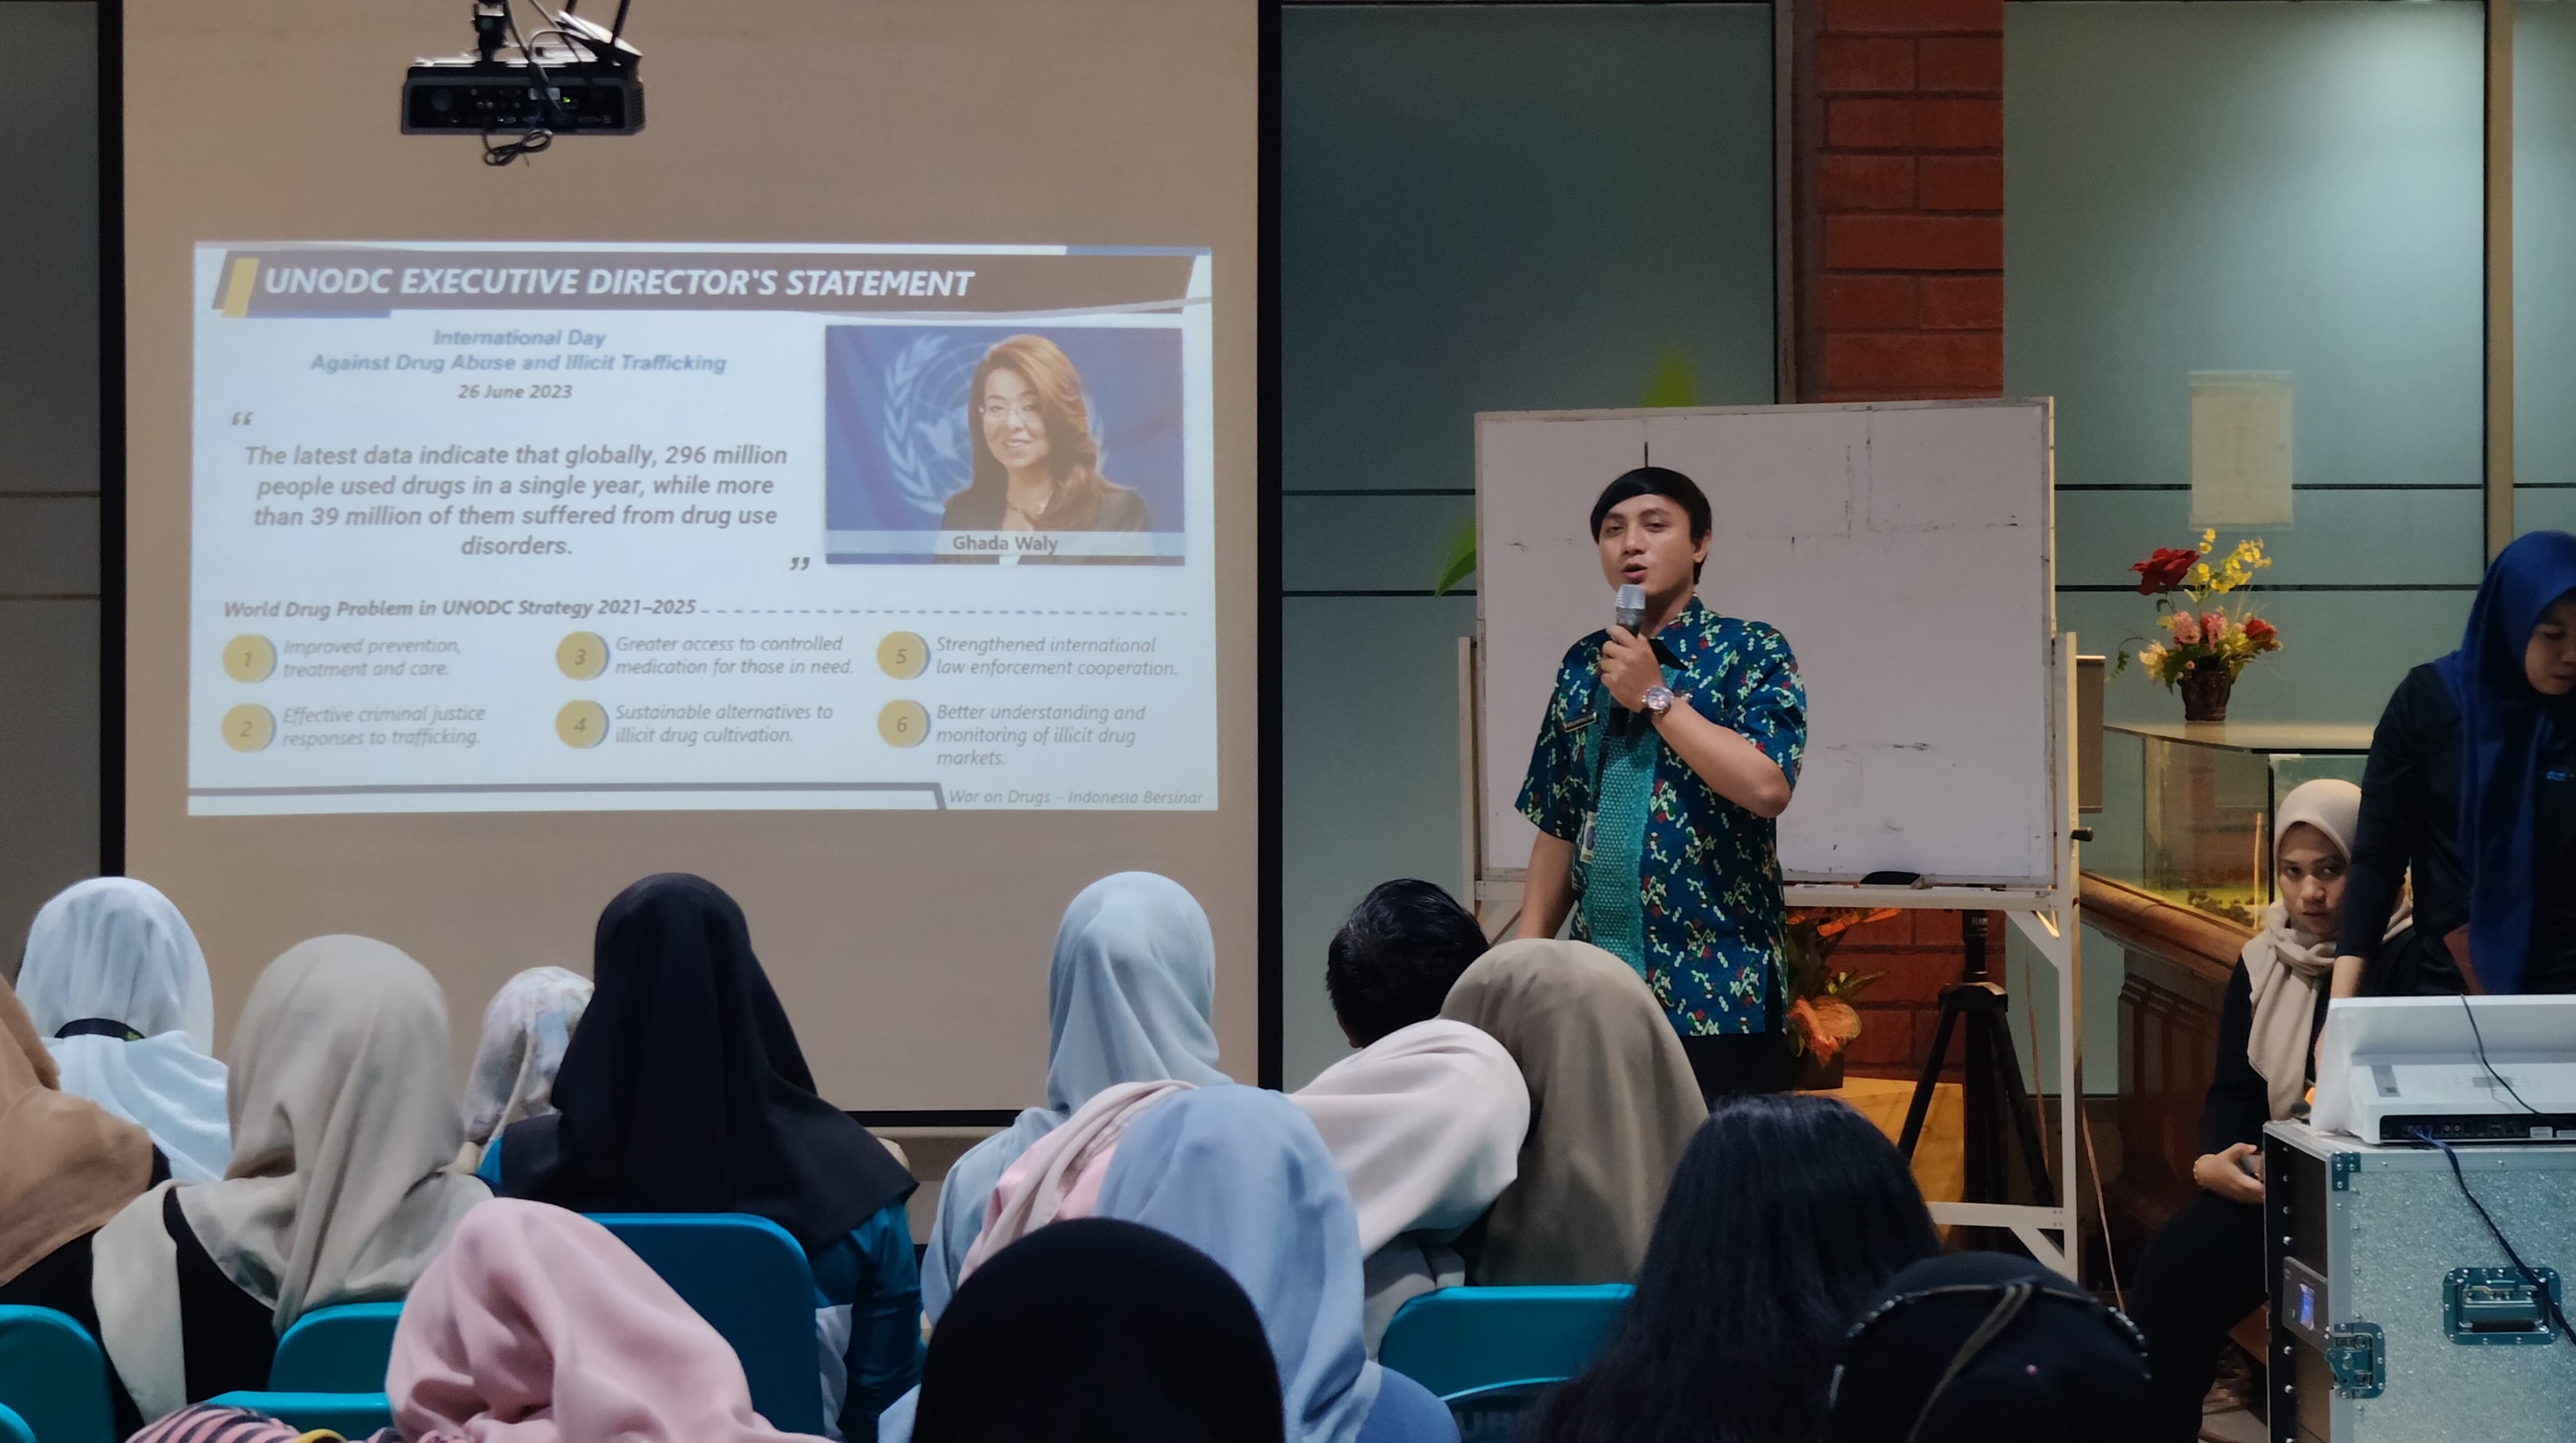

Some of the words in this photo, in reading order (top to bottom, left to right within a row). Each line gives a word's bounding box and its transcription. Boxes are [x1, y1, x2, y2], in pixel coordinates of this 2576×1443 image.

[265, 268, 393, 294] UNODC
[400, 268, 581, 294] EXECUTIVE
[586, 269, 778, 295] DIRECTOR'S
[785, 269, 976, 297] STATEMENT
[433, 329, 563, 346] International
[566, 329, 607, 350] Day
[310, 354, 391, 375] Against
[395, 353, 446, 374] Drug
[450, 353, 517, 371] Abuse
[521, 354, 562, 371] and
[564, 353, 616, 371] Illicit
[620, 353, 728, 376] Trafficking
[457, 384, 480, 399] 26
[482, 384, 526, 399] June
[528, 384, 573, 399] 2023
[245, 445, 287, 465] The
[293, 444, 358, 465] latest
[363, 444, 413, 464] data
[419, 444, 510, 464] indicate
[515, 444, 560, 464] that
[564, 443, 657, 469] globally,
[664, 445, 707, 464] 296
[712, 444, 788, 464] million
[256, 475, 334, 501] people
[341, 475, 396, 495] used
[401, 474, 466, 500] drugs
[472, 475, 493, 495] in
[498, 480, 513, 495] a
[518, 474, 586, 500] single
[591, 480, 645, 500] year,
[653, 474, 711, 495] while
[716, 480, 775, 495] more
[254, 506, 303, 526] than
[310, 507, 339, 526] 39
[345, 505, 422, 526] million
[428, 505, 455, 525] of
[458, 505, 515, 525] them
[521, 504, 617, 525] suffered
[622, 504, 674, 524] from
[680, 505, 732, 529] drug
[738, 509, 778, 525] use
[460, 534, 573, 555] disorders.
[953, 535, 1009, 550] Ghada
[1014, 535, 1058, 555] Waly
[224, 601, 281, 617] World
[284, 601, 331, 622] Drug
[336, 600, 414, 617] Problem
[418, 599, 437, 616] in
[442, 599, 515, 615] UNODC
[517, 599, 594, 620] Strategy
[283, 638, 363, 657] Improved
[366, 638, 461, 657] prevention,
[615, 636, 679, 652] Greater
[681, 639, 734, 651] access
[739, 637, 755, 651] to
[760, 635, 844, 651] controlled
[935, 636, 1046, 656] Strengthened
[1049, 636, 1156, 652] international
[244, 652, 253, 667] 1
[574, 649, 587, 665] 3
[895, 649, 908, 664] 5
[283, 662, 369, 678] treatment
[372, 660, 407, 677] and
[409, 663, 448, 676] care.
[614, 658, 708, 674] medication
[712, 657, 737, 677] for
[740, 658, 785, 674] those
[789, 658, 806, 674] in
[809, 658, 853, 674] need.
[935, 658, 967, 674] law
[970, 657, 1073, 678] enforcement
[1077, 661, 1177, 680] cooperation.
[282, 706, 354, 726] Effective
[357, 706, 429, 722] criminal
[432, 704, 486, 726] justice
[615, 704, 712, 720] Sustainable
[715, 703, 812, 720] alternatives
[816, 705, 833, 719] to
[936, 704, 986, 720] Better
[990, 704, 1110, 725] understanding
[1113, 704, 1146, 721] and
[240, 721, 253, 737] 2
[573, 717, 587, 733] 4
[897, 717, 908, 733] 6
[282, 733, 365, 750] responses
[368, 731, 387, 745] to
[391, 727, 481, 749] trafficking.
[615, 727, 656, 743] illicit
[659, 726, 698, 747] drug
[702, 726, 793, 743] cultivation.
[936, 726, 1027, 748] monitoring
[1032, 726, 1051, 746] of
[1053, 726, 1094, 743] illicit
[1097, 727, 1136, 748] drug
[936, 748, 1005, 766] markets.
[949, 790, 980, 804] War
[983, 792, 1003, 803] on
[1006, 789, 1051, 807] Drugs
[1068, 790, 1139, 804] Indonesia
[1142, 790, 1204, 805] Bersinar
